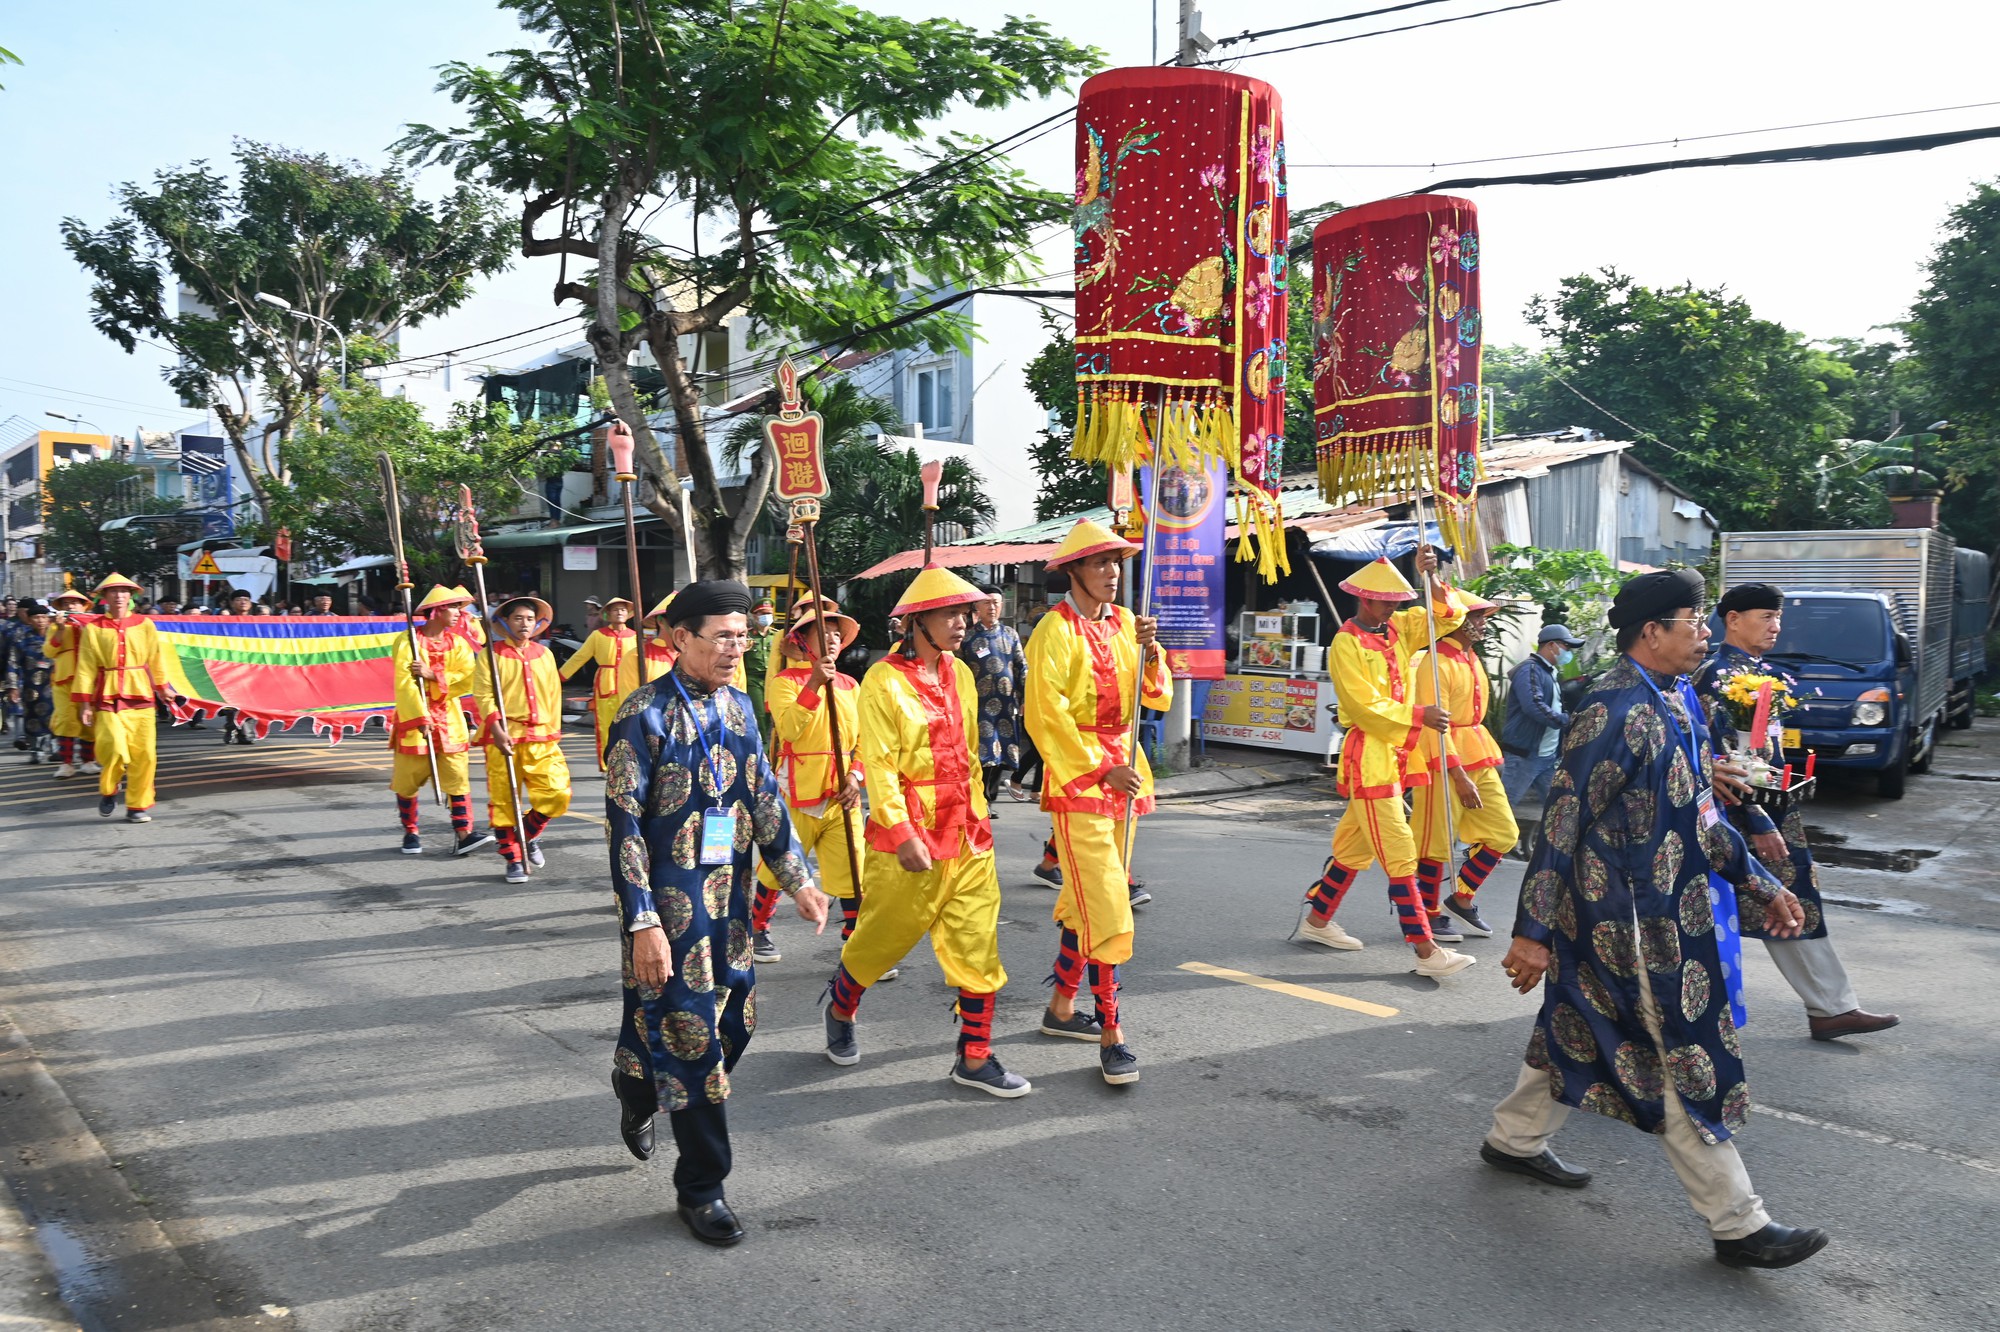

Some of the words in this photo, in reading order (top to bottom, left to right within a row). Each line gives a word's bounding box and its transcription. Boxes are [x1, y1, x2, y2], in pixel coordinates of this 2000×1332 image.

[780, 431, 816, 491] 迴避
[1165, 535, 1179, 549] LỄ
[1180, 537, 1200, 551] HỘI
[1192, 553, 1215, 565] ÔNG
[1262, 730, 1281, 740] 45K
